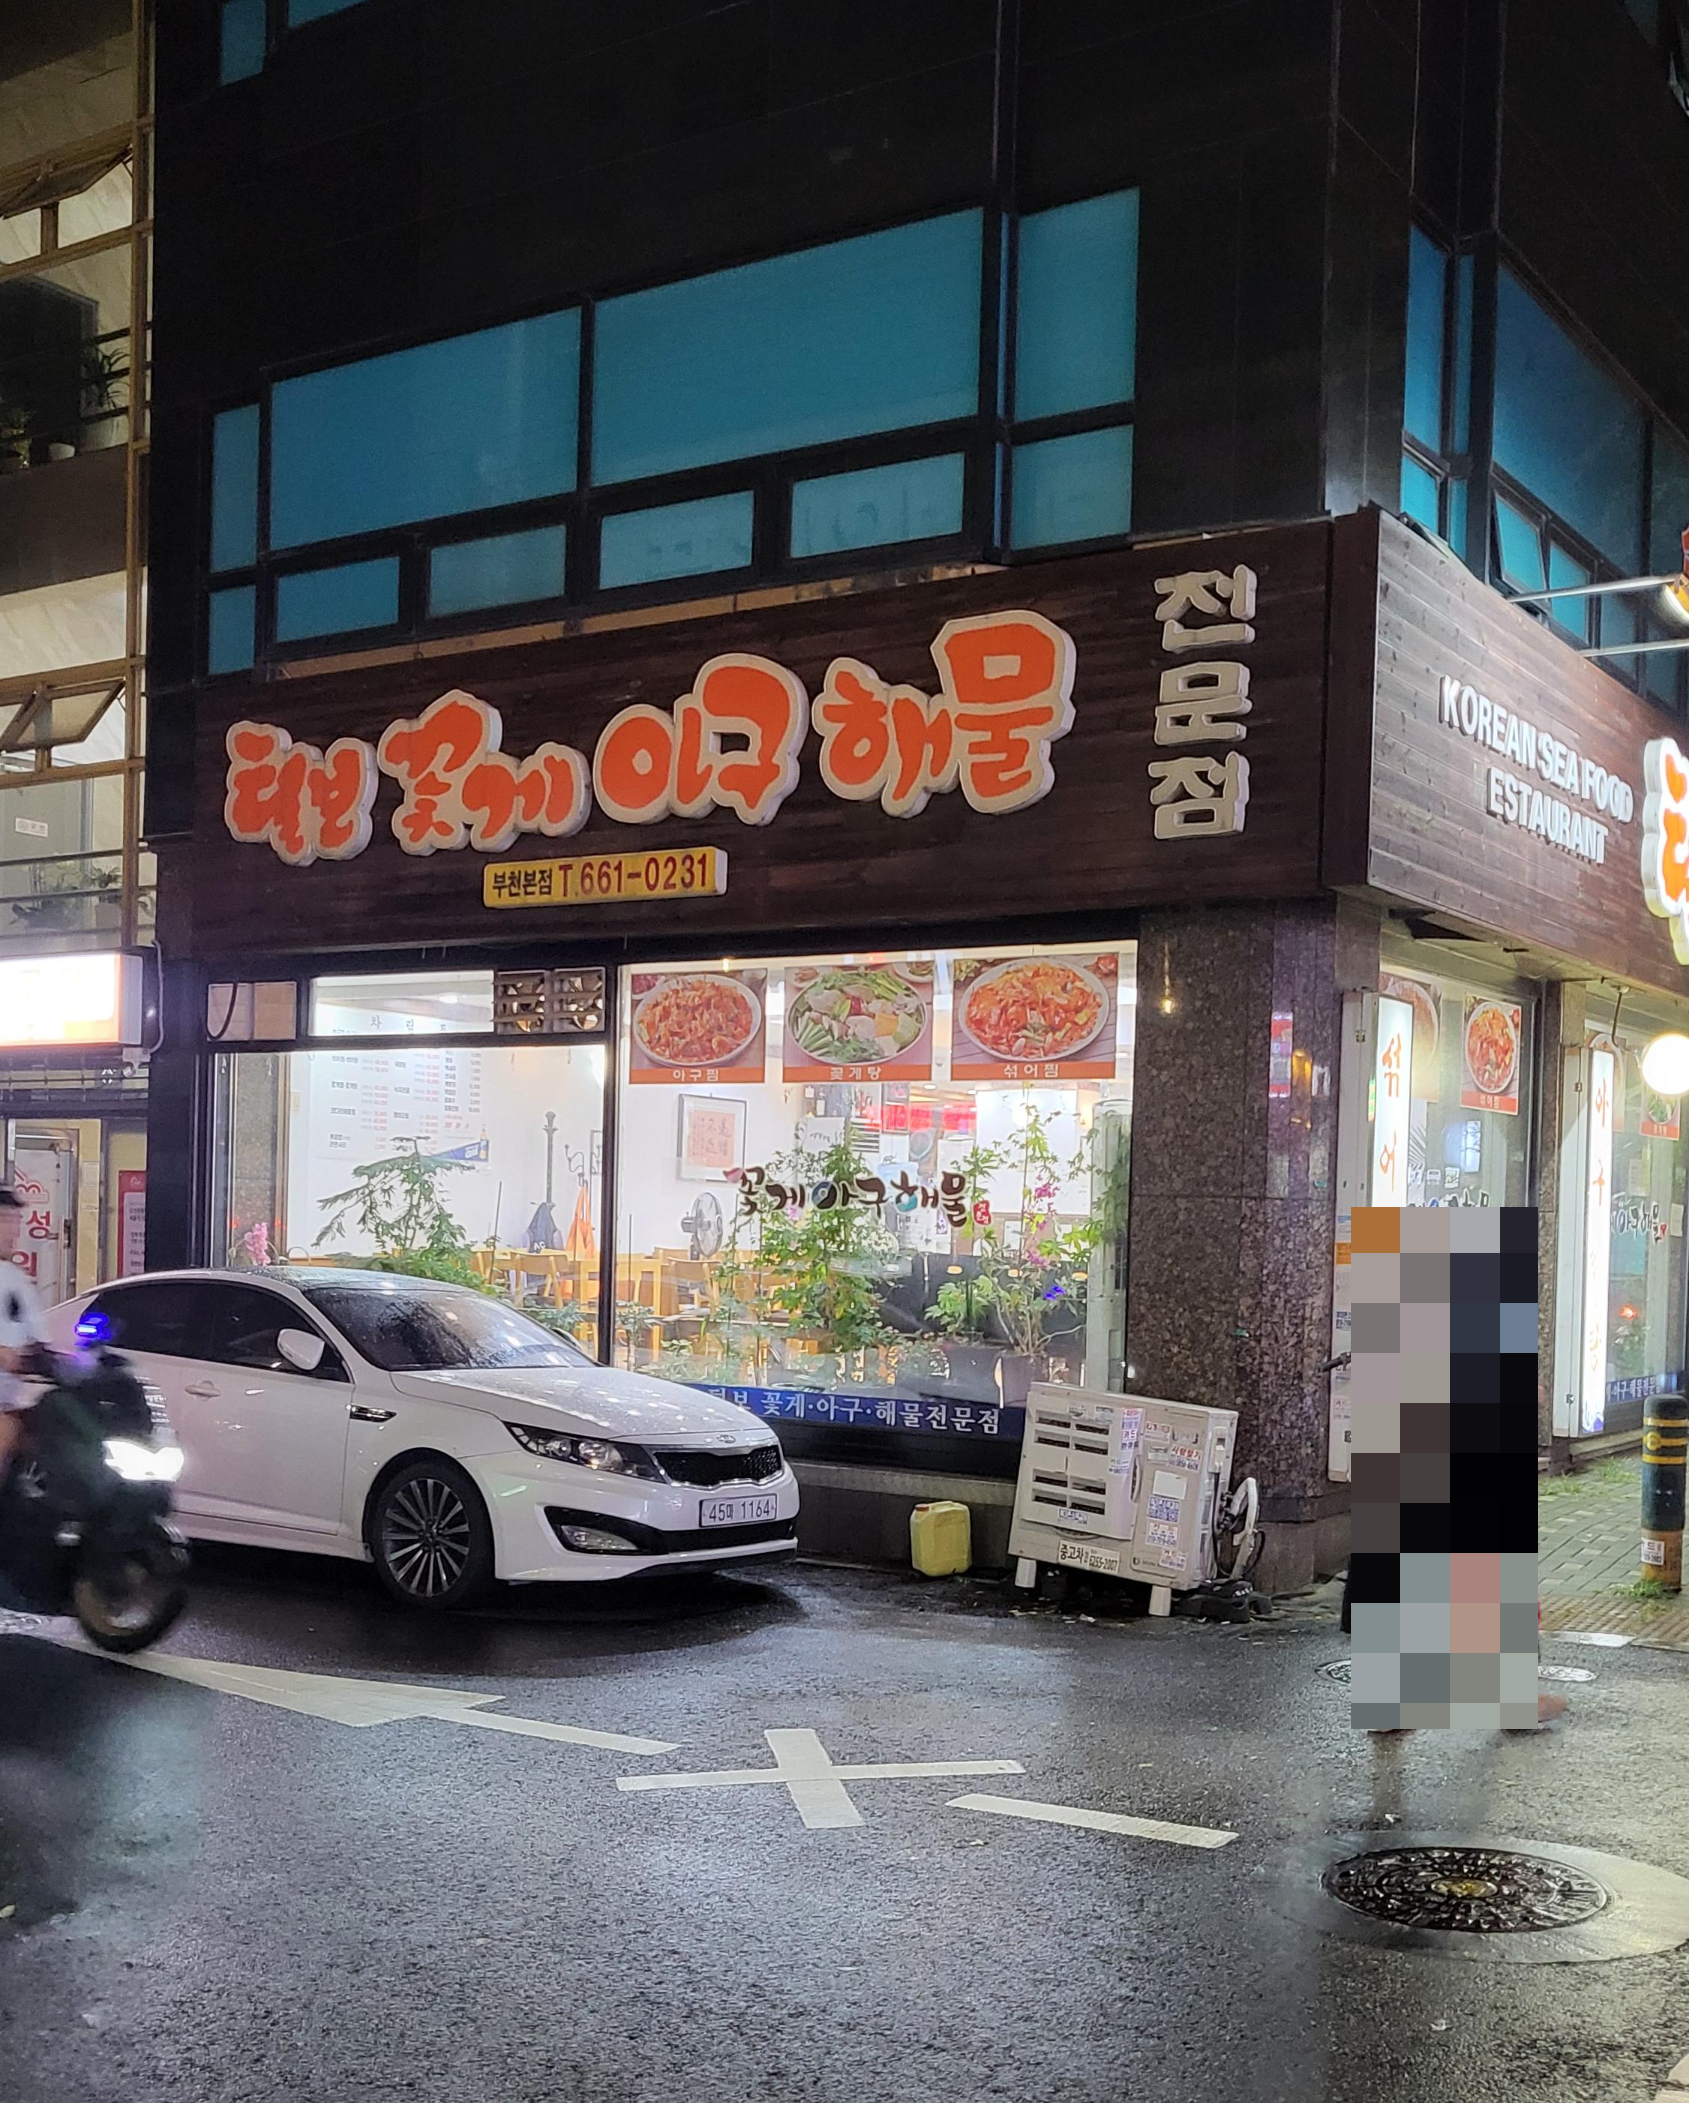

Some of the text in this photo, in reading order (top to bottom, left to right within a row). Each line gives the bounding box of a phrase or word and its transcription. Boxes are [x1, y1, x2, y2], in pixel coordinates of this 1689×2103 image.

[1149, 564, 1256, 839] 전문점
[378, 690, 588, 855] 꽃게
[595, 653, 806, 824] 아구
[812, 610, 1072, 817] 해물
[1439, 674, 1634, 825] KOREAN SEA FOOD
[1487, 768, 1608, 865] ESTAURANT
[491, 867, 553, 898] 부천본점
[672, 1069, 719, 1082] 아구찜
[829, 1065, 882, 1081] 꽃게탕
[1003, 1062, 1060, 1079] 섞어찜
[741, 1499, 770, 1519] 1164
[1060, 1543, 1084, 1564] 중고차
